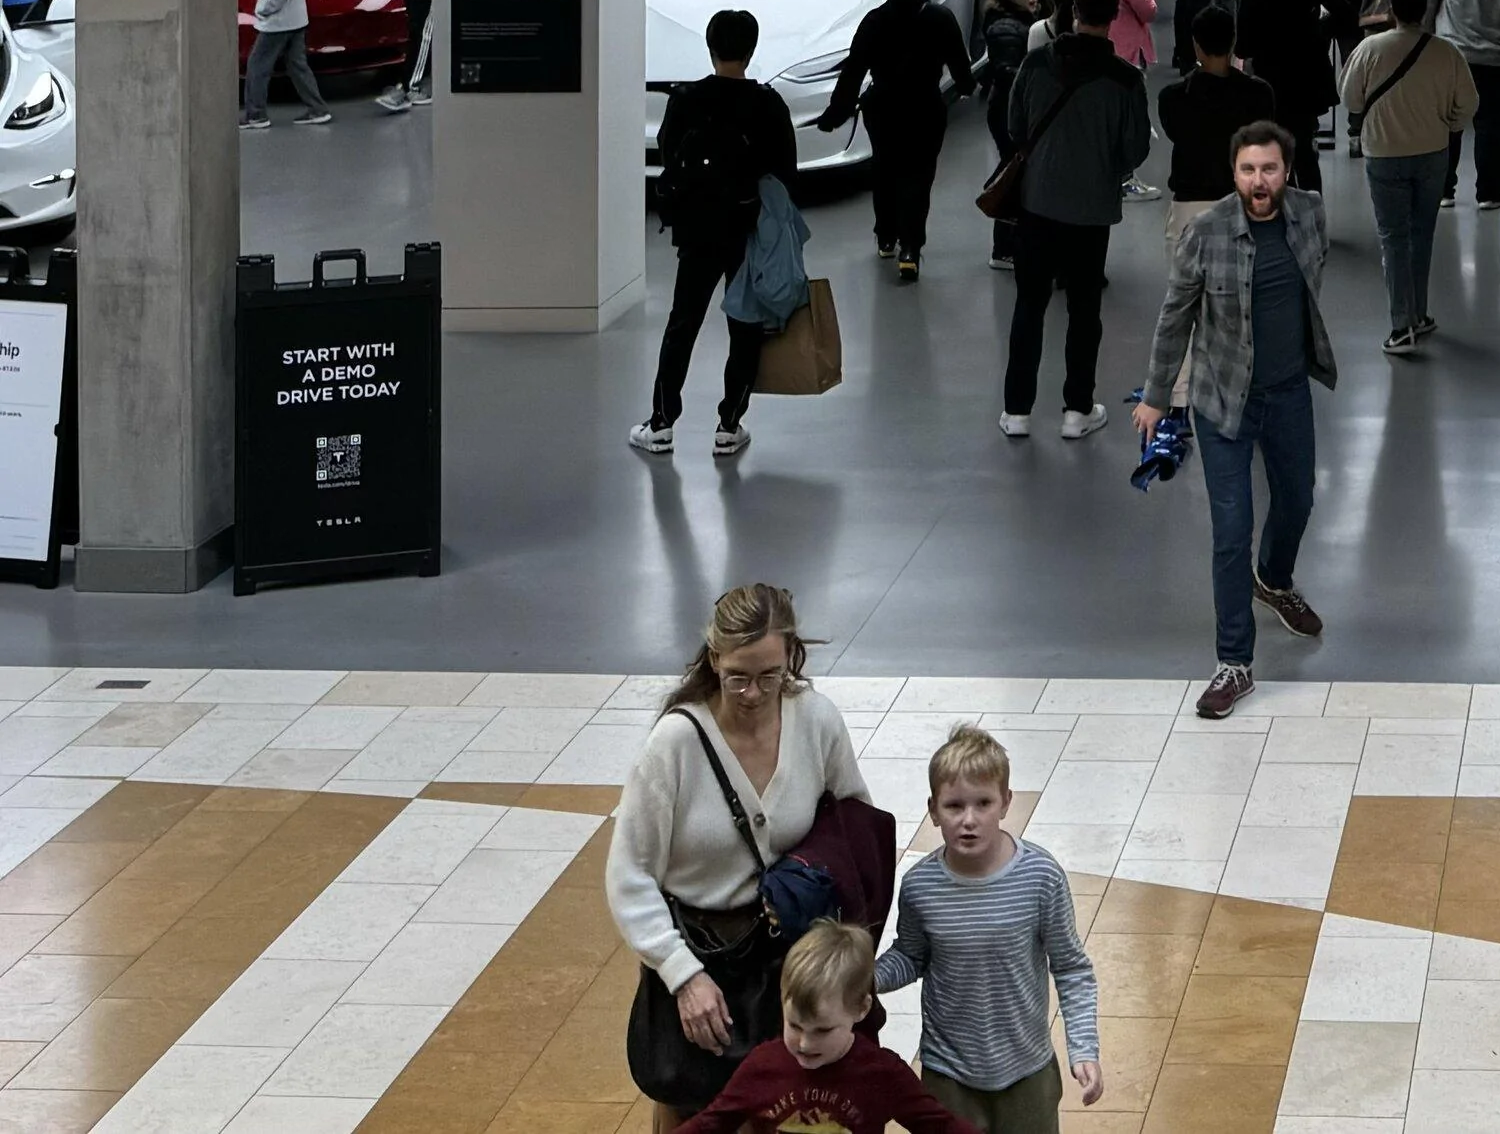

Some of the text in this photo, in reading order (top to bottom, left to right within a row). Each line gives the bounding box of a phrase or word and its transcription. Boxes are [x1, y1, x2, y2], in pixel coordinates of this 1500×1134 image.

[282, 342, 395, 365] START WITH
[302, 363, 376, 384] A DEMO
[277, 381, 401, 405] DRIVE TODAY
[316, 516, 362, 527] TESLA
[804, 1088, 838, 1105] YOUR
